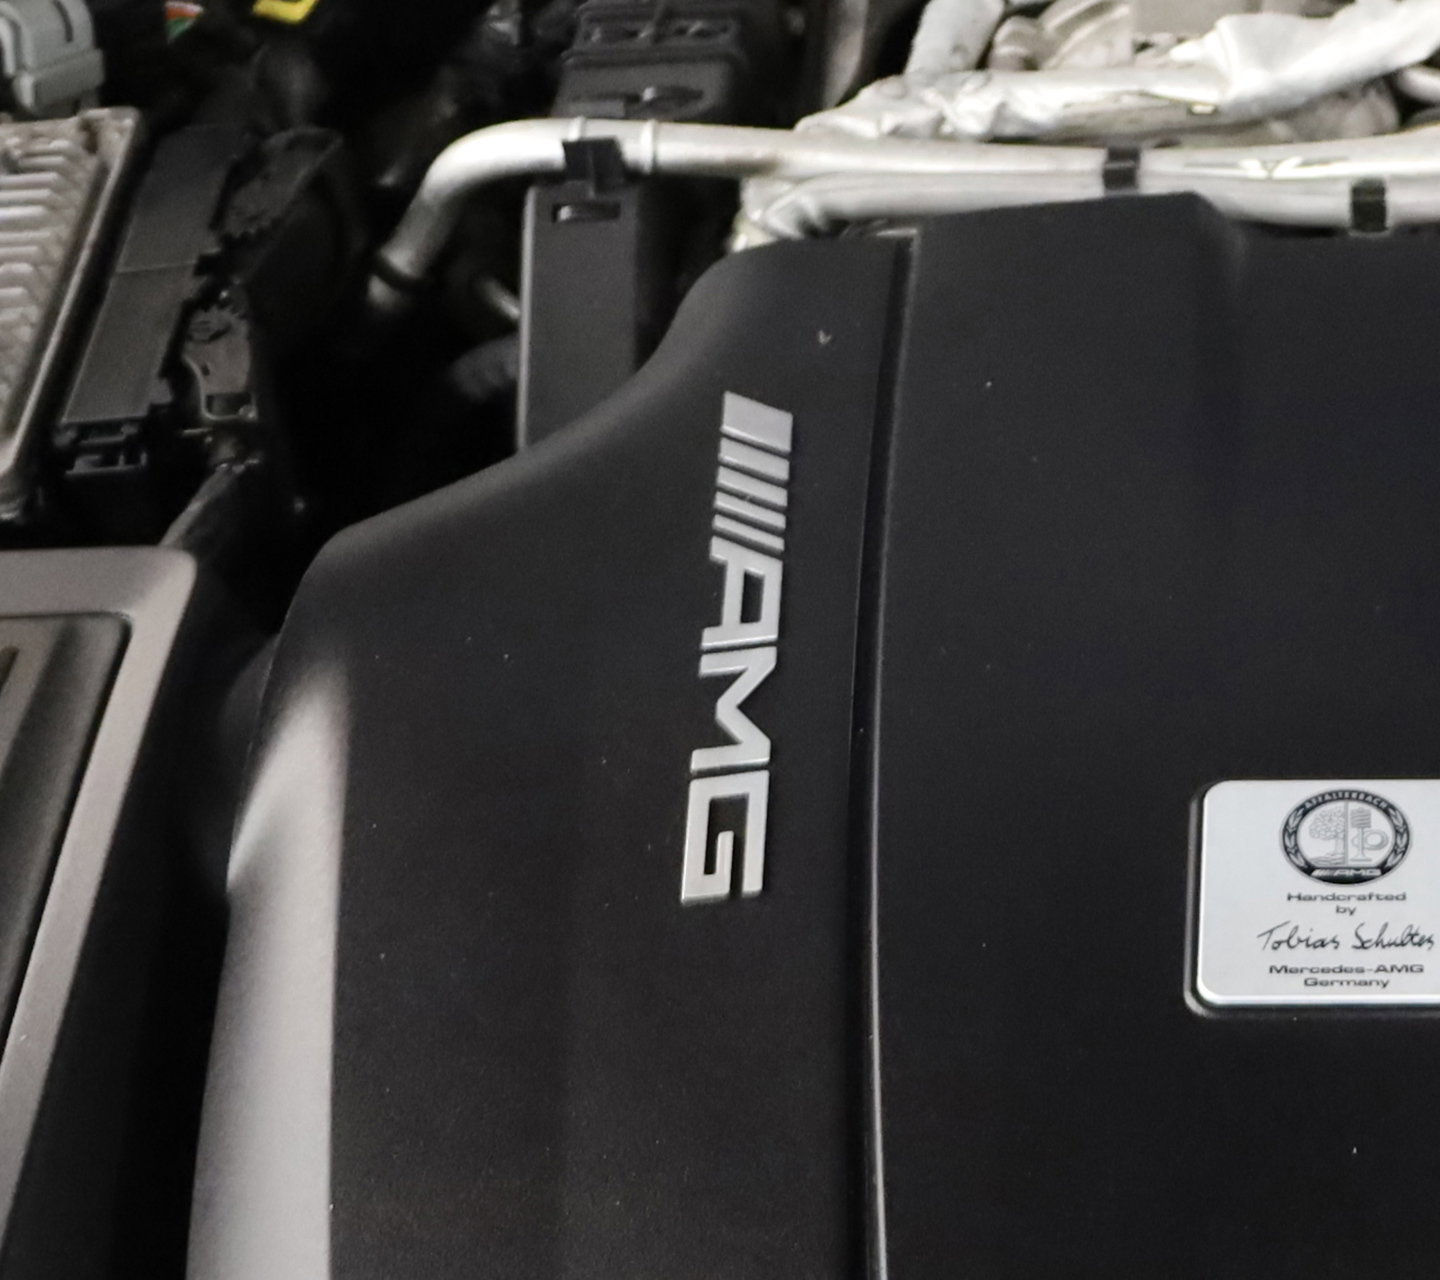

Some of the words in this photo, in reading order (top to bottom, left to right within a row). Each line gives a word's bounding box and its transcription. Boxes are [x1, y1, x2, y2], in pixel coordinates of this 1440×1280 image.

[680, 534, 784, 906] AMG
[1304, 791, 1389, 809] AFFALTERBACH
[1286, 891, 1407, 902] Handcrafted
[1335, 904, 1357, 916] by
[1257, 920, 1341, 952] Tobias
[1268, 964, 1425, 974] Mercedes-AMG
[1303, 977, 1391, 989] Germany
